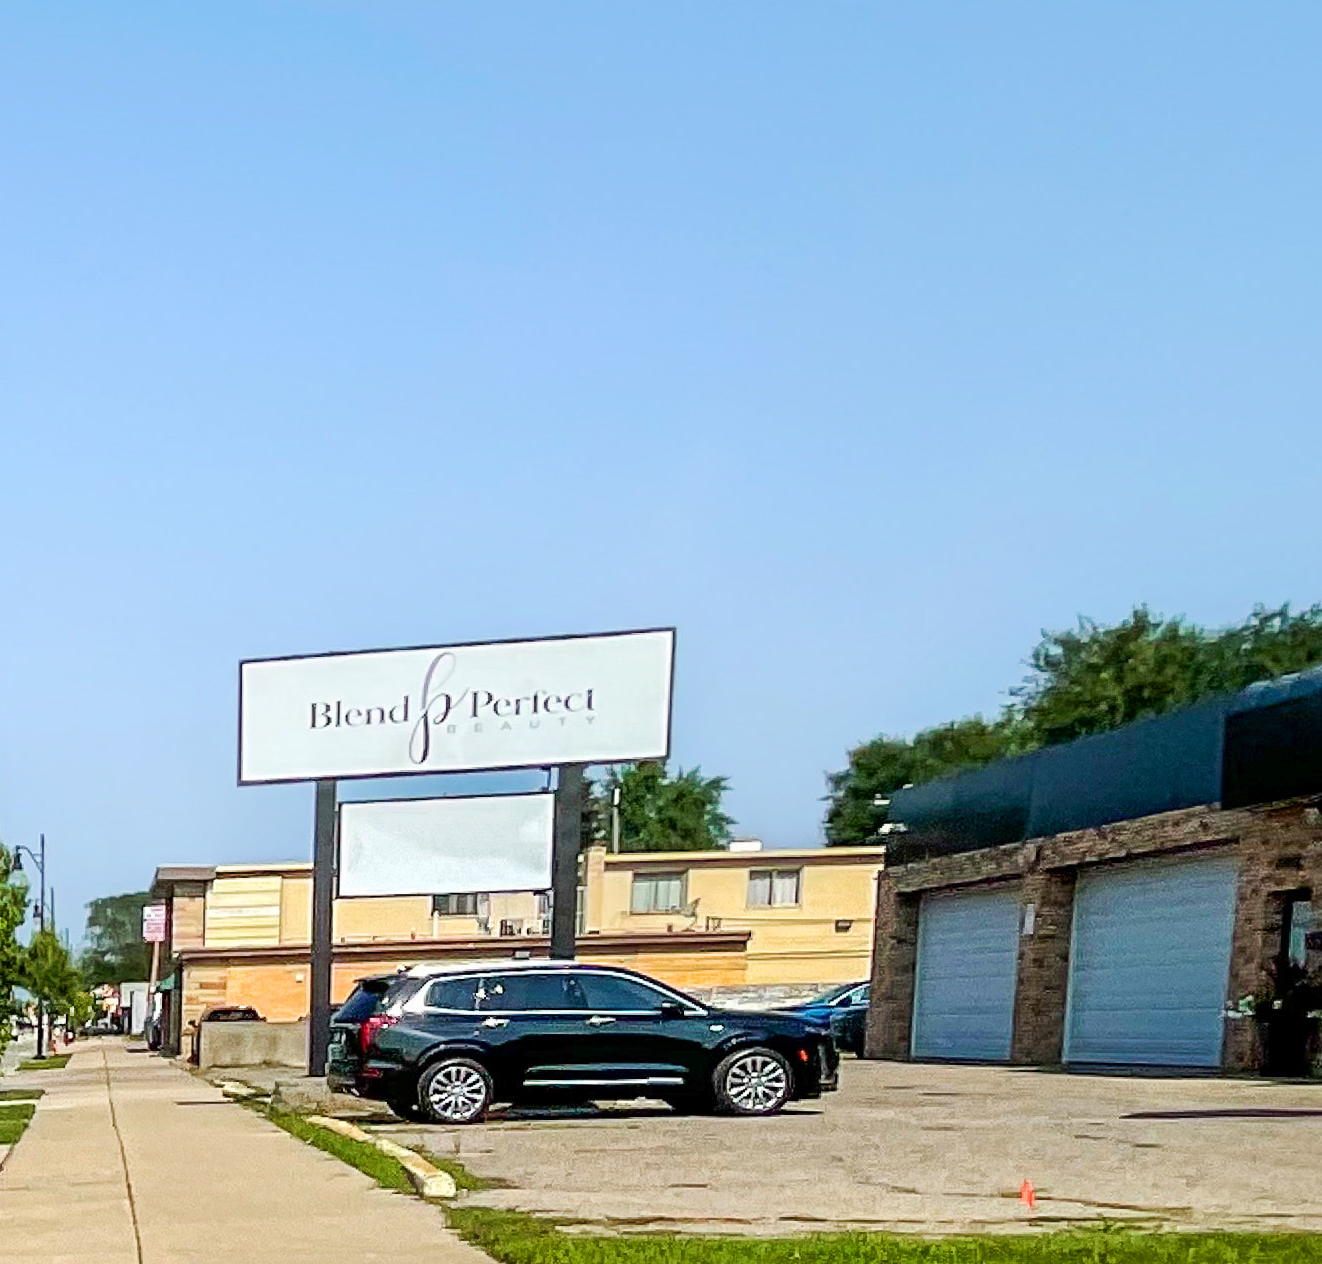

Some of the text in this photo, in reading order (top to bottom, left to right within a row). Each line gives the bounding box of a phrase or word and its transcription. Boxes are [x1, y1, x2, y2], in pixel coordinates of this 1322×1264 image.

[310, 688, 595, 730] Blend Perfect
[447, 715, 596, 735] BEAUTY
